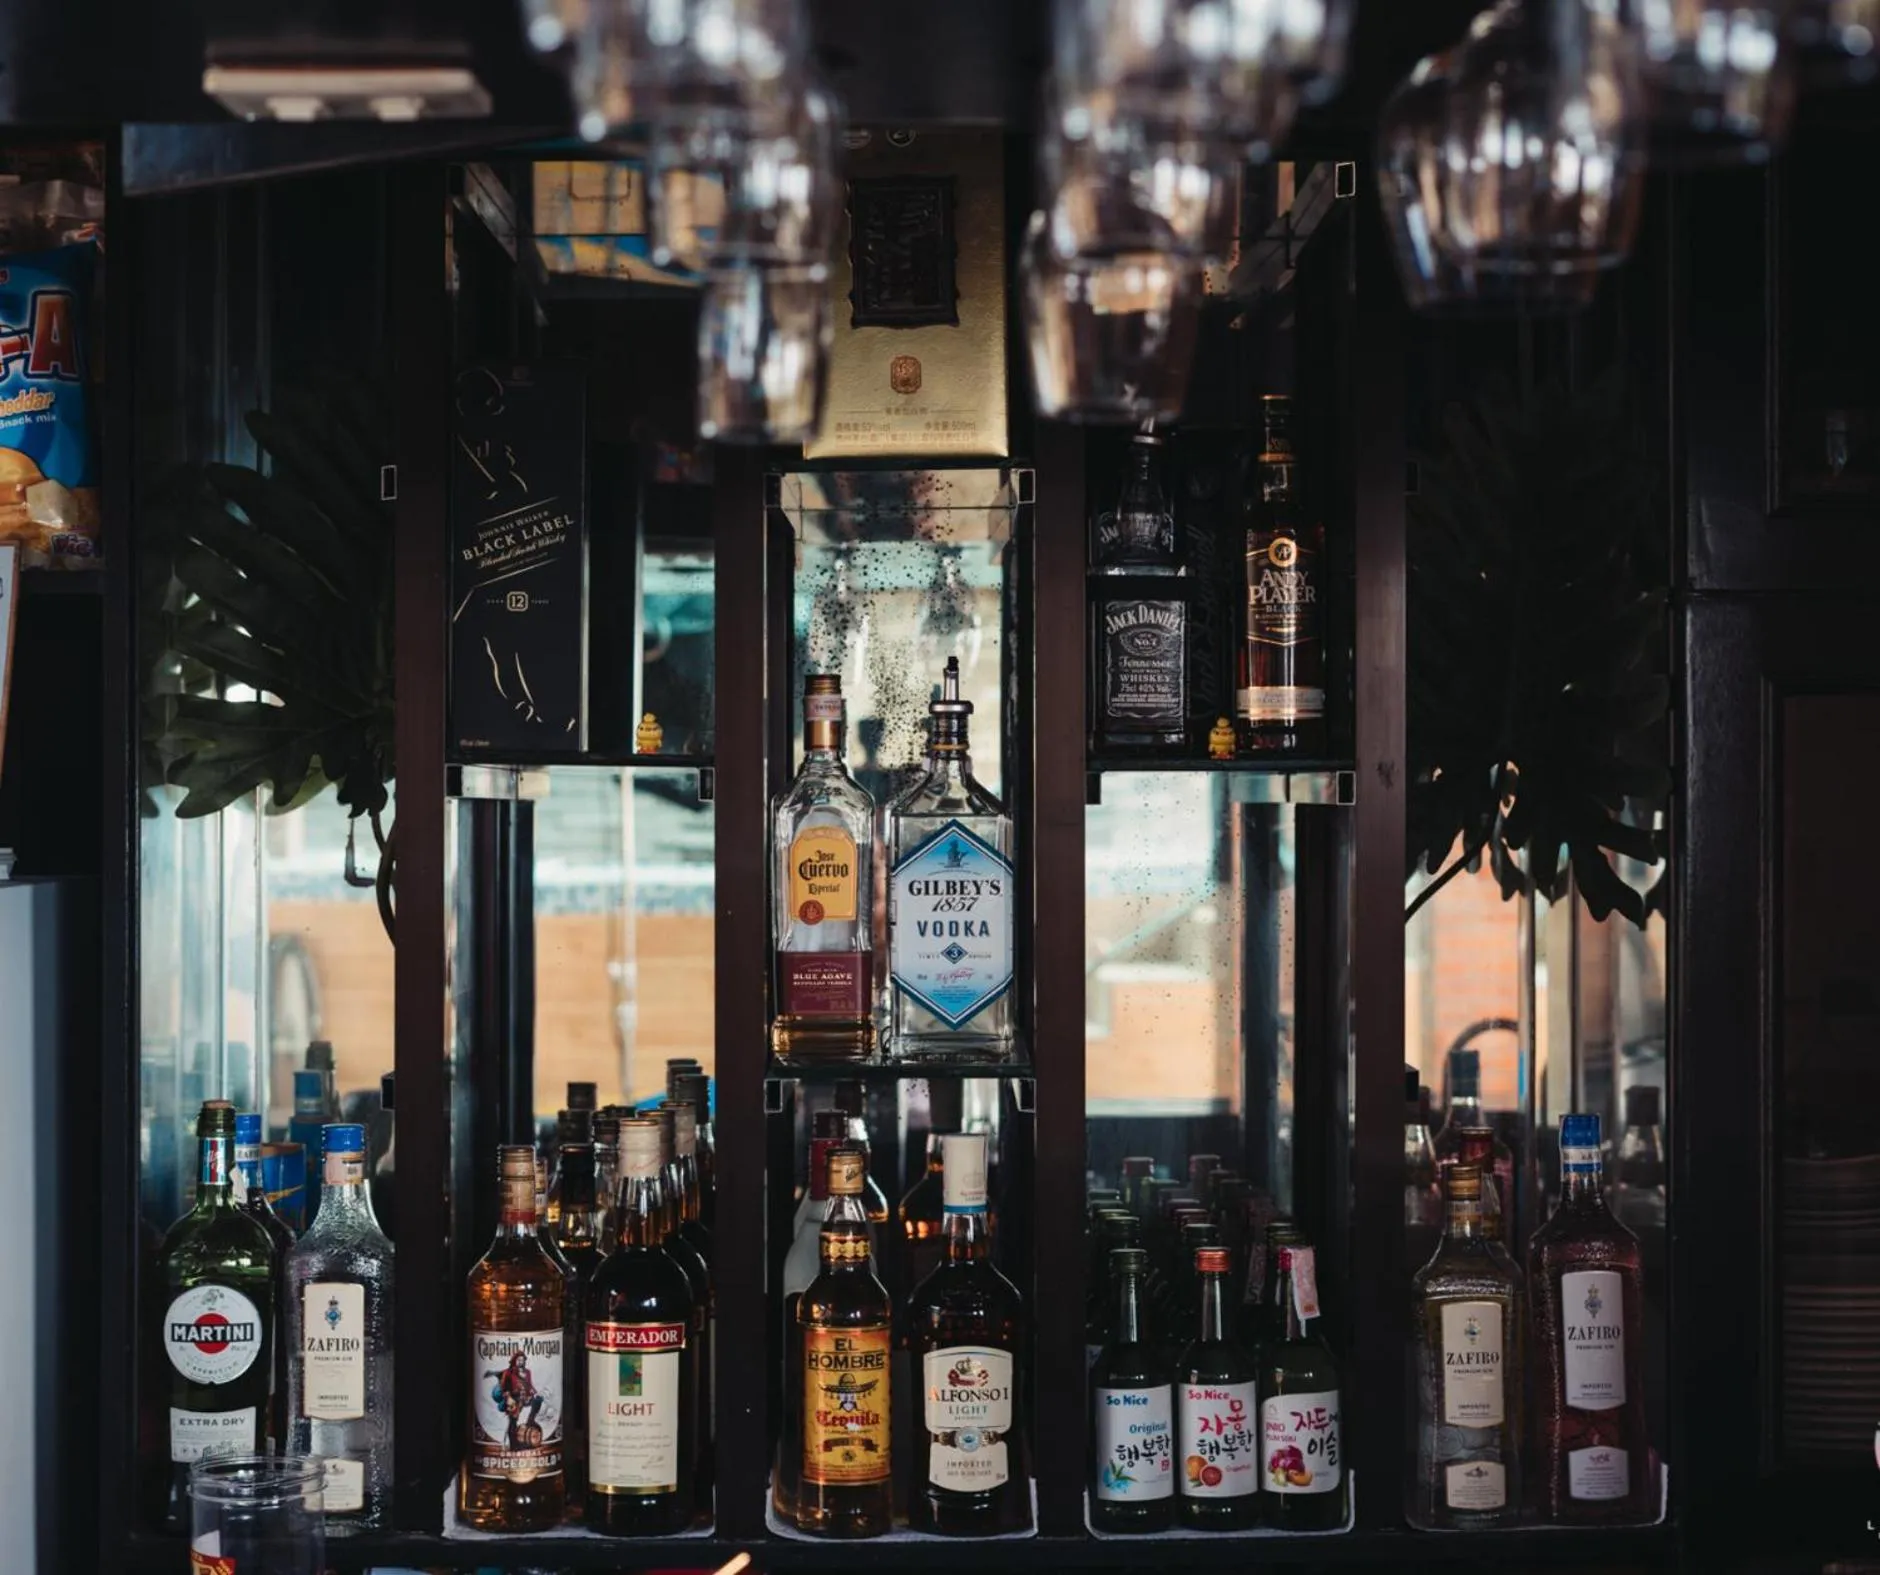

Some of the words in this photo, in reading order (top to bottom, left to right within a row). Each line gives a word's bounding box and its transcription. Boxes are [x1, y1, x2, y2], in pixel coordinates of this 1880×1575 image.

[462, 534, 516, 560] BLACK
[521, 514, 575, 540] LABEL
[1260, 568, 1309, 588] ANDY
[511, 595, 525, 608] 12
[1248, 585, 1317, 604] PLAYER
[1106, 609, 1137, 634] JACK
[1119, 673, 1170, 682] WHISKEY
[798, 858, 849, 881] Cuervo
[908, 879, 1002, 896] GILBEY'S
[932, 896, 979, 912] 1857
[917, 920, 990, 937] VODKA
[173, 1325, 252, 1341] MARTINI
[589, 1328, 678, 1345] EMPERADOR
[1567, 1325, 1621, 1341] ZAFIRO
[307, 1337, 360, 1352] ZAFIRO
[478, 1336, 519, 1361] Captain
[523, 1336, 560, 1358] Morgan
[834, 1337, 858, 1351] EL
[807, 1353, 885, 1369] HOMBRE
[1446, 1351, 1500, 1366] ZAFIRO
[929, 1385, 1000, 1402] ALFONSO
[1106, 1394, 1121, 1406] So
[1123, 1393, 1148, 1406] Nice
[1188, 1389, 1202, 1400] So
[1204, 1389, 1230, 1400] Nice
[608, 1402, 655, 1416] LIGHT
[948, 1405, 989, 1415] LIGHT
[179, 1417, 218, 1426] EXTRA
[222, 1416, 247, 1426] DRY
[816, 1409, 880, 1430] Tequila
[1198, 1399, 1248, 1436] 자몽
[1129, 1420, 1168, 1435] Original
[1115, 1434, 1171, 1468] 행복한
[1197, 1430, 1254, 1463] 행복한
[1307, 1431, 1338, 1467] 이슬
[482, 1456, 526, 1469] SPICED
[946, 1459, 992, 1468] IMPORTED
